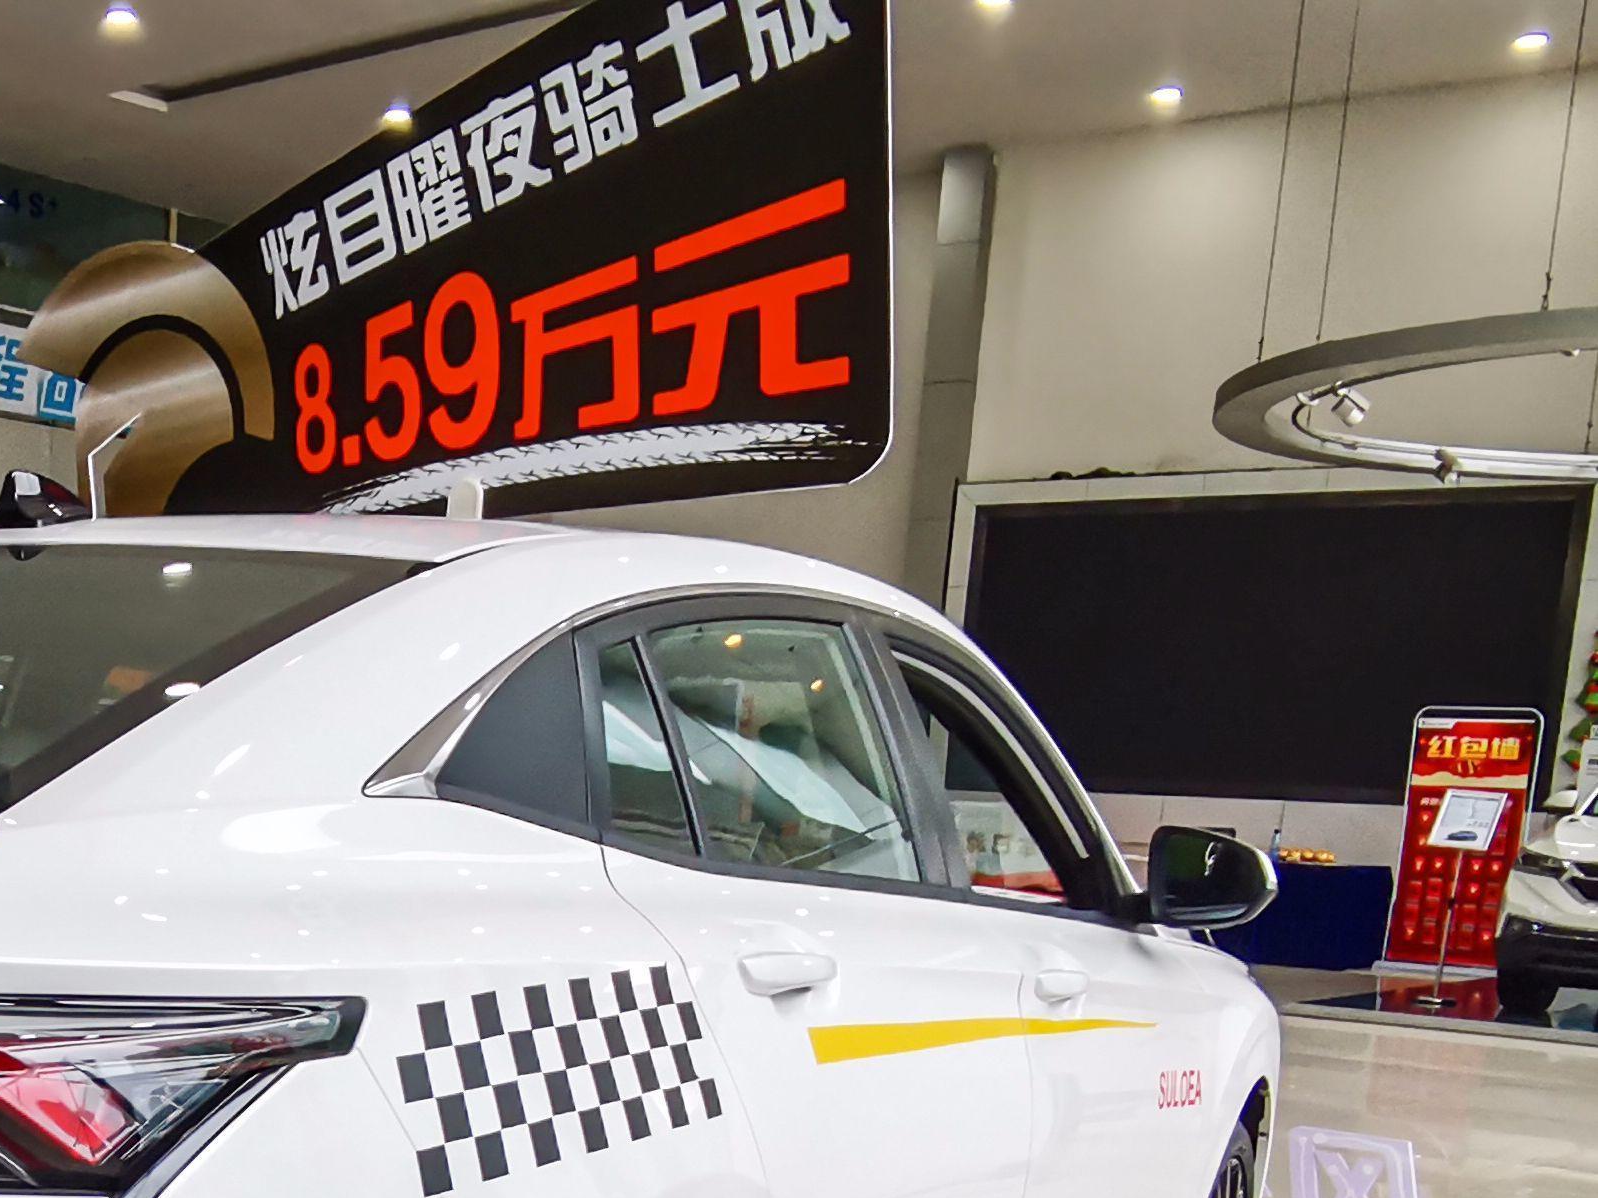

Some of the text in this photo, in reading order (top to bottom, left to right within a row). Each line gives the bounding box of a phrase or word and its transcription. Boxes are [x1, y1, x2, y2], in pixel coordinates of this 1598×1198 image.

[260, 0, 851, 319] 炫目曜夜骑士版
[294, 178, 851, 474] 8.59万元
